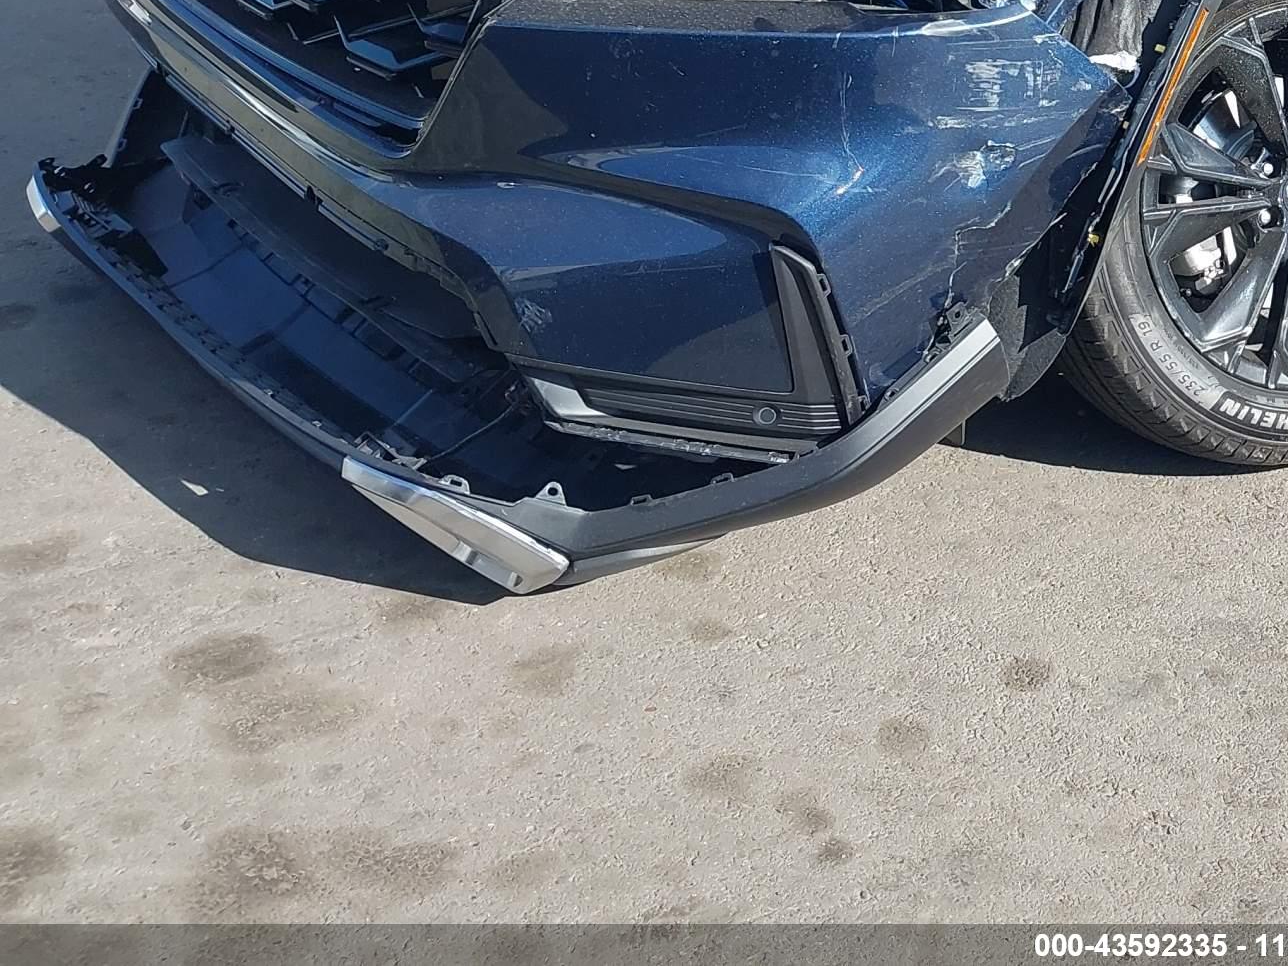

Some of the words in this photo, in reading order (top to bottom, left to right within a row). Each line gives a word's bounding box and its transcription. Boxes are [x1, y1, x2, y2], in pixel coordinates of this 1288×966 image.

[1137, 320, 1153, 337] 19
[1149, 339, 1163, 352] R
[1158, 352, 1209, 397] 235/55
